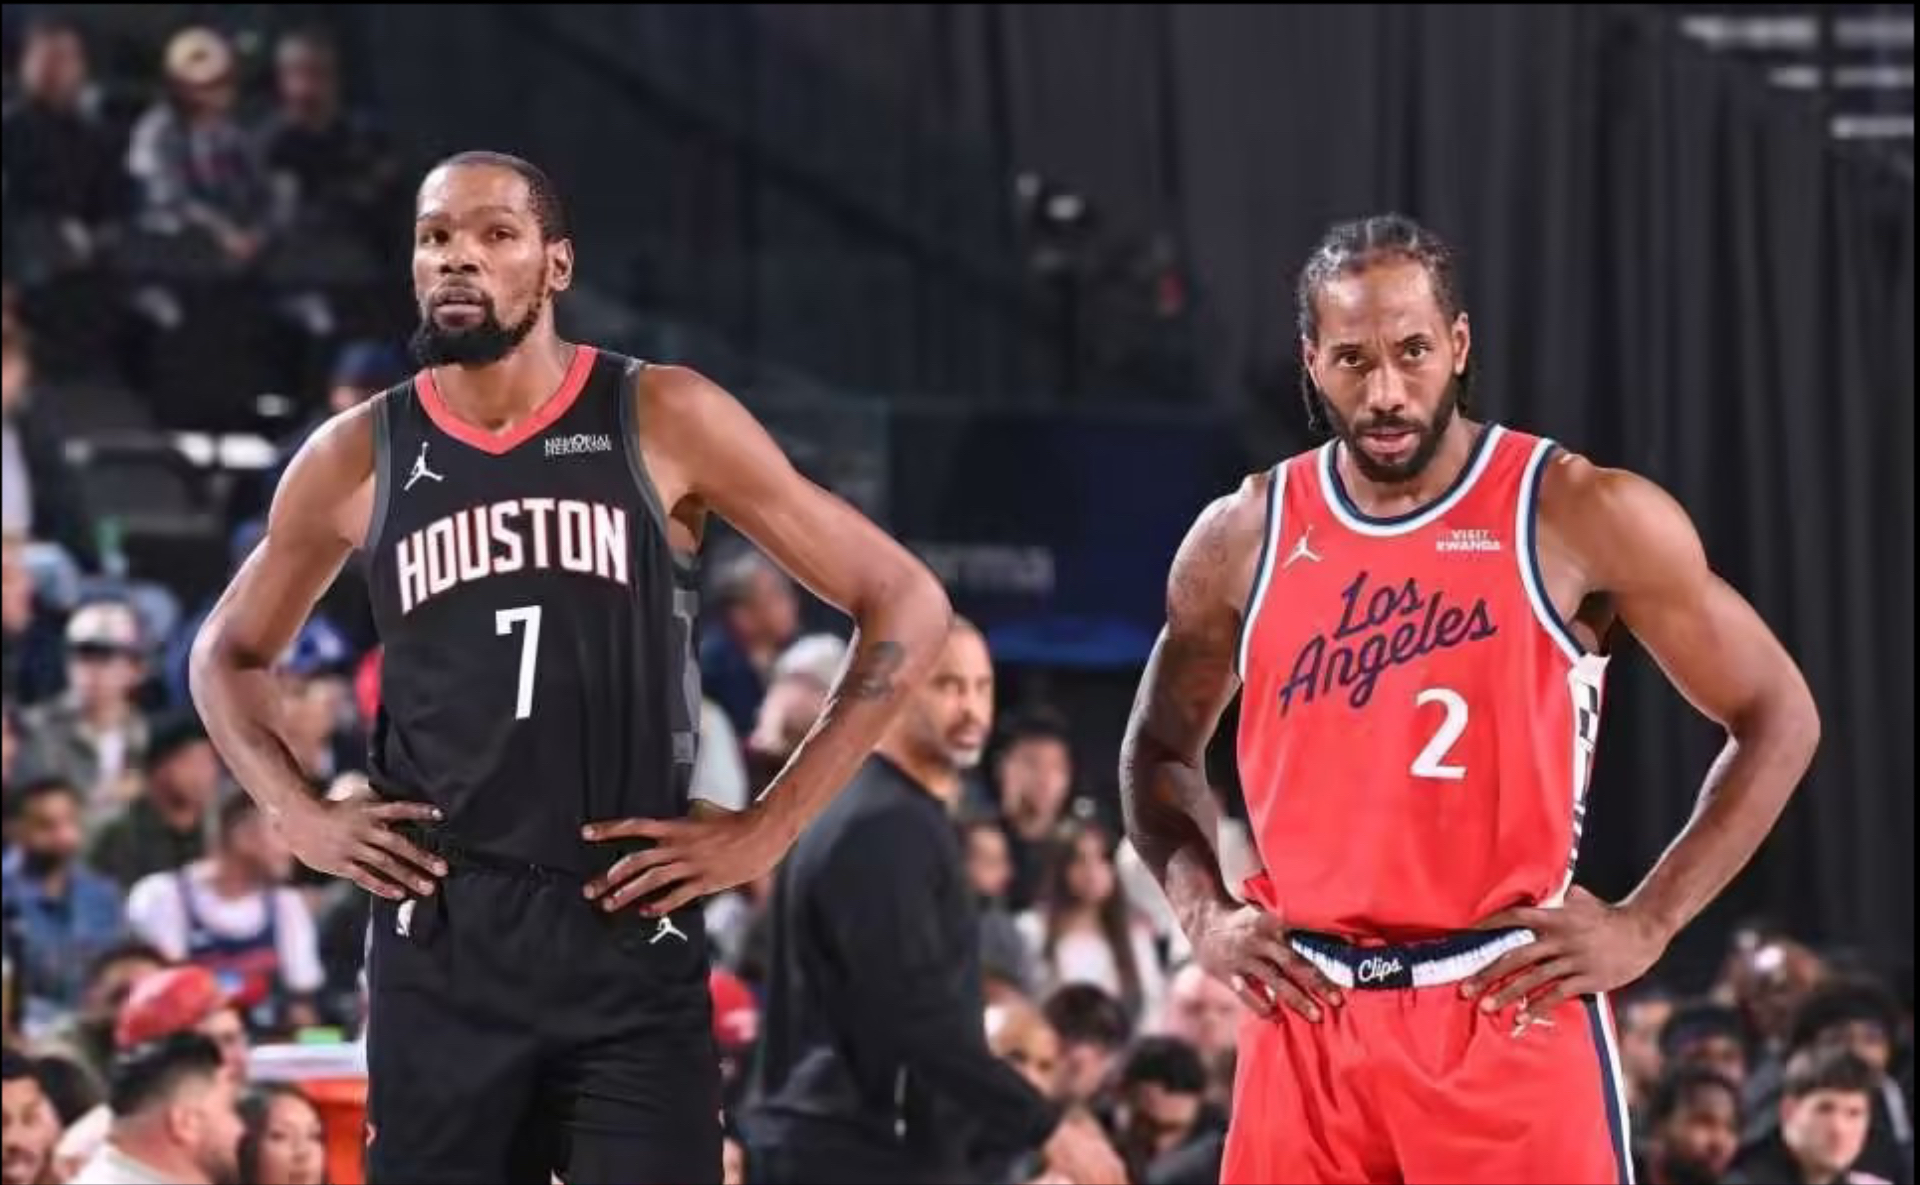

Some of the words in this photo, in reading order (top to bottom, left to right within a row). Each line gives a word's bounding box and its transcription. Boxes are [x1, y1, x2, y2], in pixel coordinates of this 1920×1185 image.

[395, 497, 630, 616] HOUSTON
[1436, 540, 1501, 551] RWANDA
[1452, 529, 1489, 539] VISIT
[1333, 570, 1424, 640] Los
[495, 605, 542, 720] 7
[1279, 591, 1498, 718] Angeles
[1409, 688, 1469, 780] 2
[1358, 955, 1403, 982] Clips
